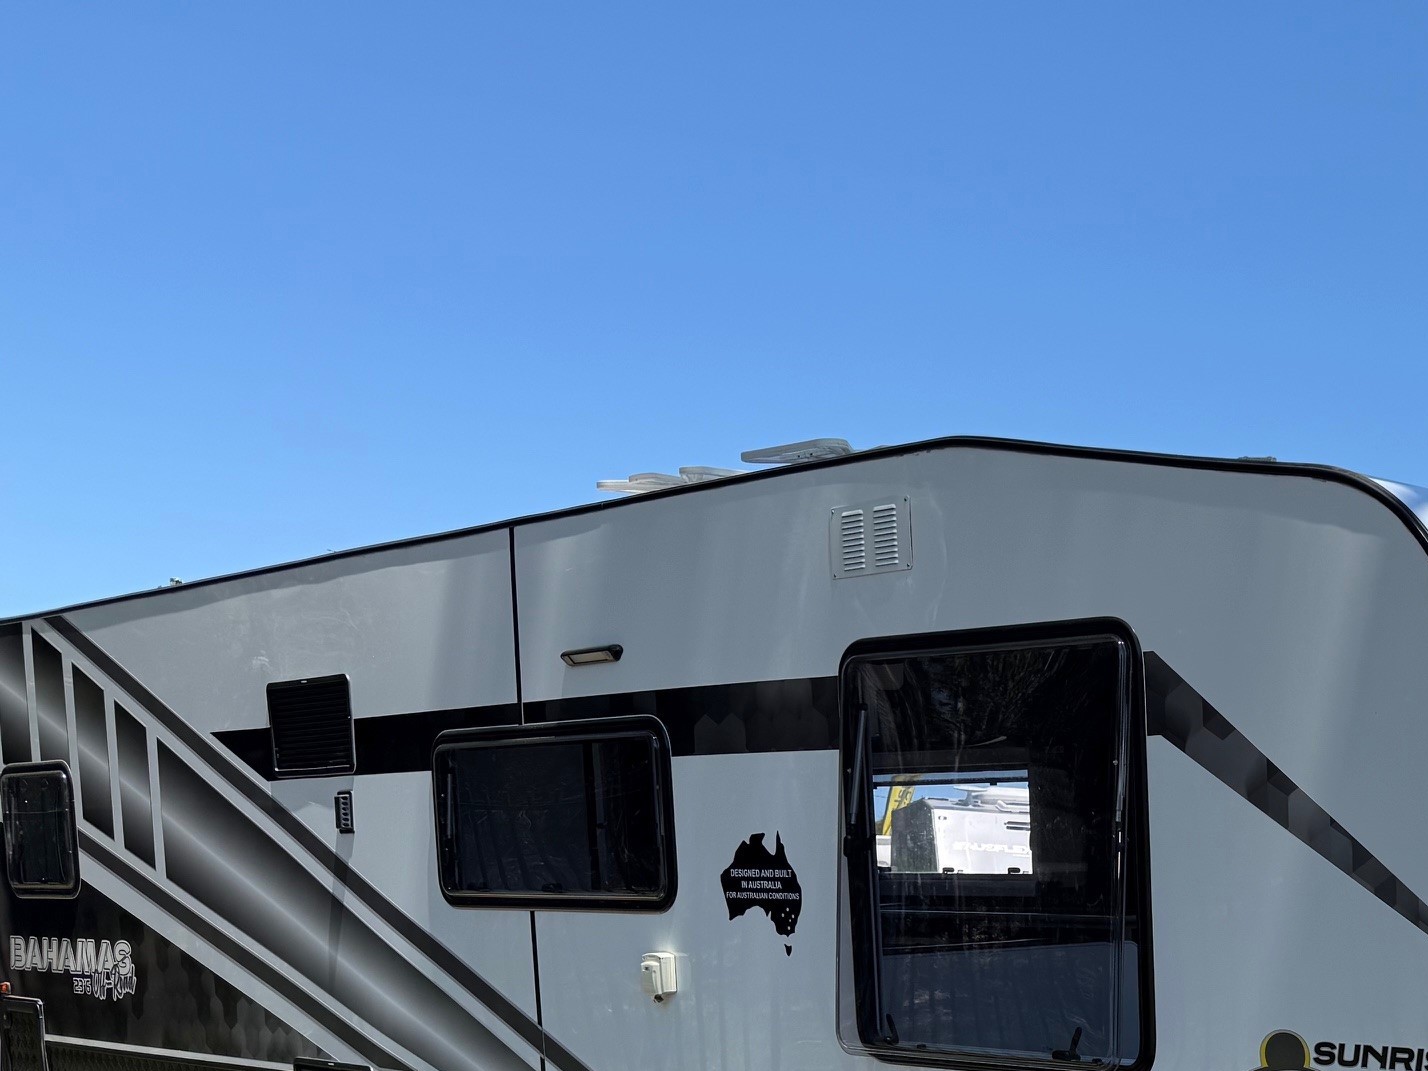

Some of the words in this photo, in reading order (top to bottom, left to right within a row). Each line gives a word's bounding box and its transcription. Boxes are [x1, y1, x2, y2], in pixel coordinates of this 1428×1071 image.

[730, 869, 760, 878] DESIGNED
[761, 869, 774, 878] AND
[775, 870, 792, 878] BUILT
[741, 880, 748, 889] IN
[749, 880, 783, 890] AUSTRALIA
[726, 891, 737, 899] FOR
[737, 891, 768, 900] AUSTRALIAN
[769, 892, 800, 900] CONDITIONS
[10, 935, 131, 975] BAHAMAS
